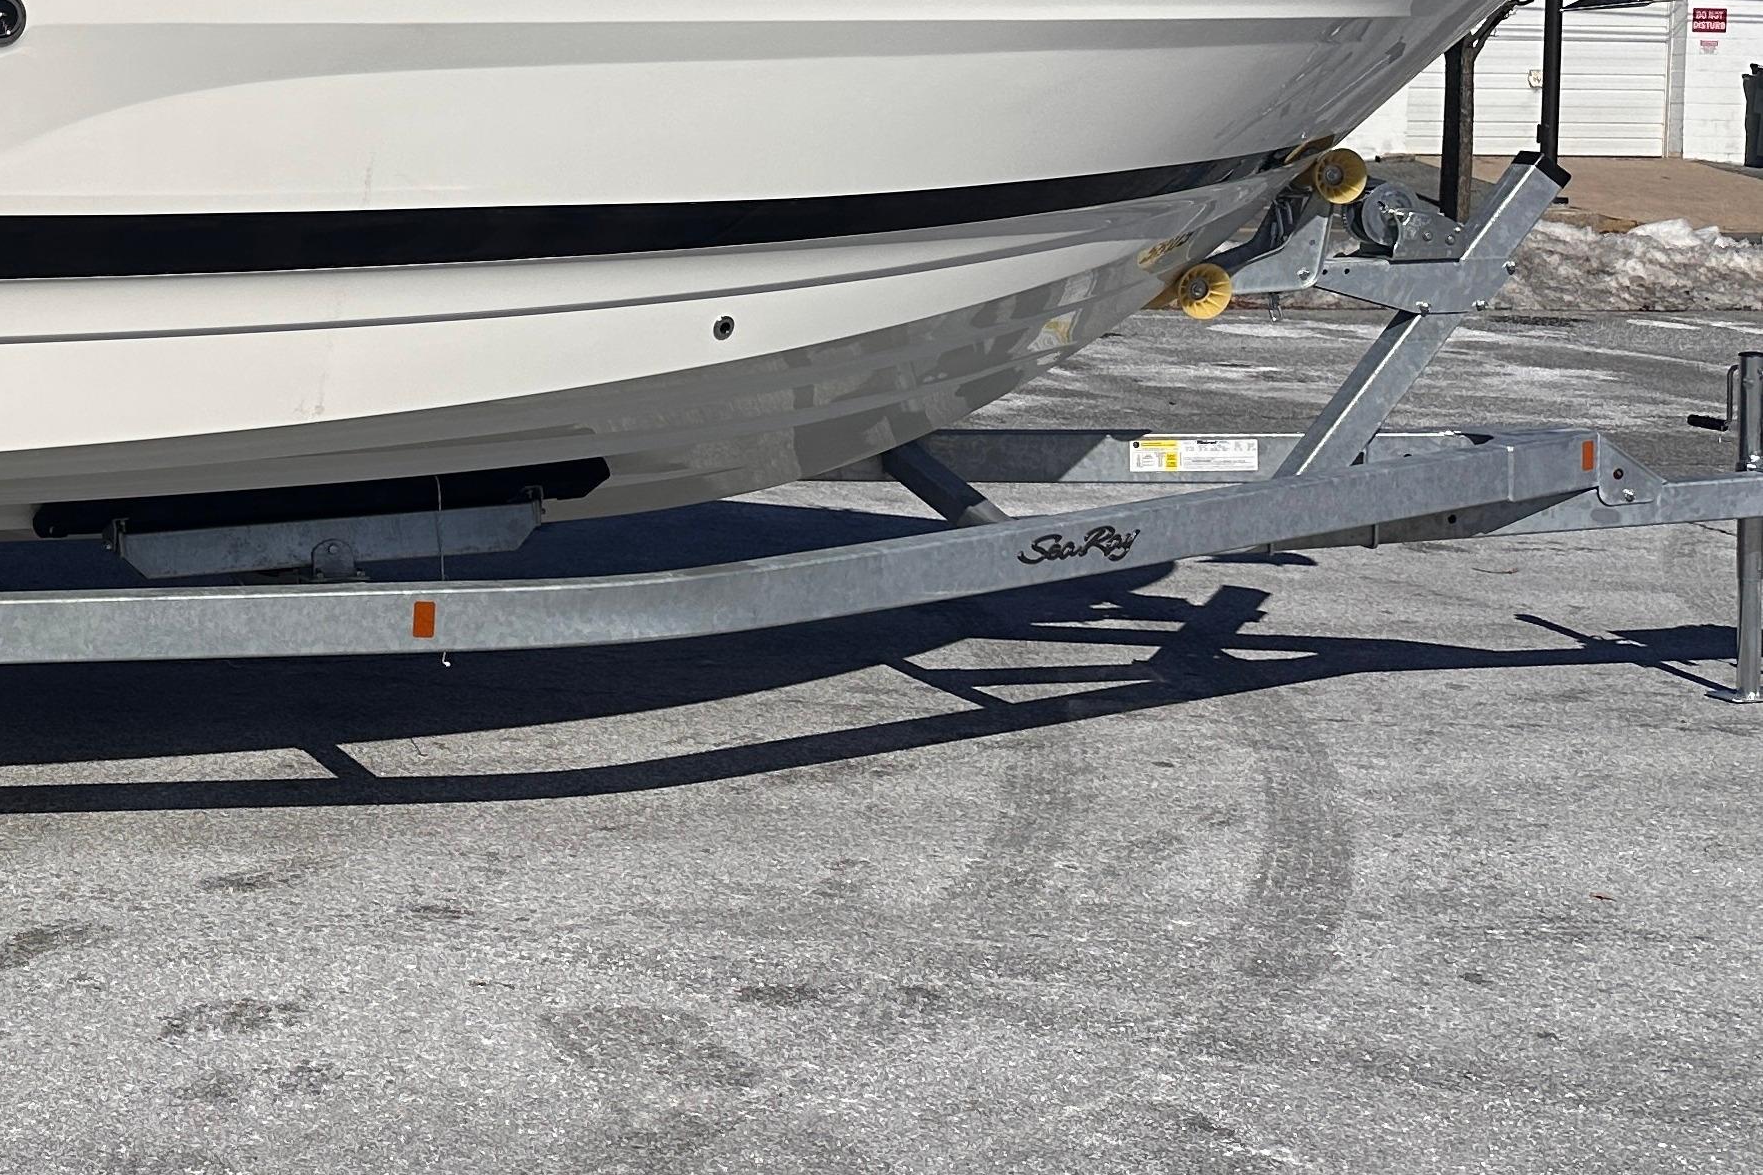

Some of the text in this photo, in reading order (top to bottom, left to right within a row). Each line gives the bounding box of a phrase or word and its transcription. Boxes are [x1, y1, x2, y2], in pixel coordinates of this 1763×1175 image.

[1693, 21, 1725, 30] DISTURB
[1017, 525, 1141, 565] Sea Ray
